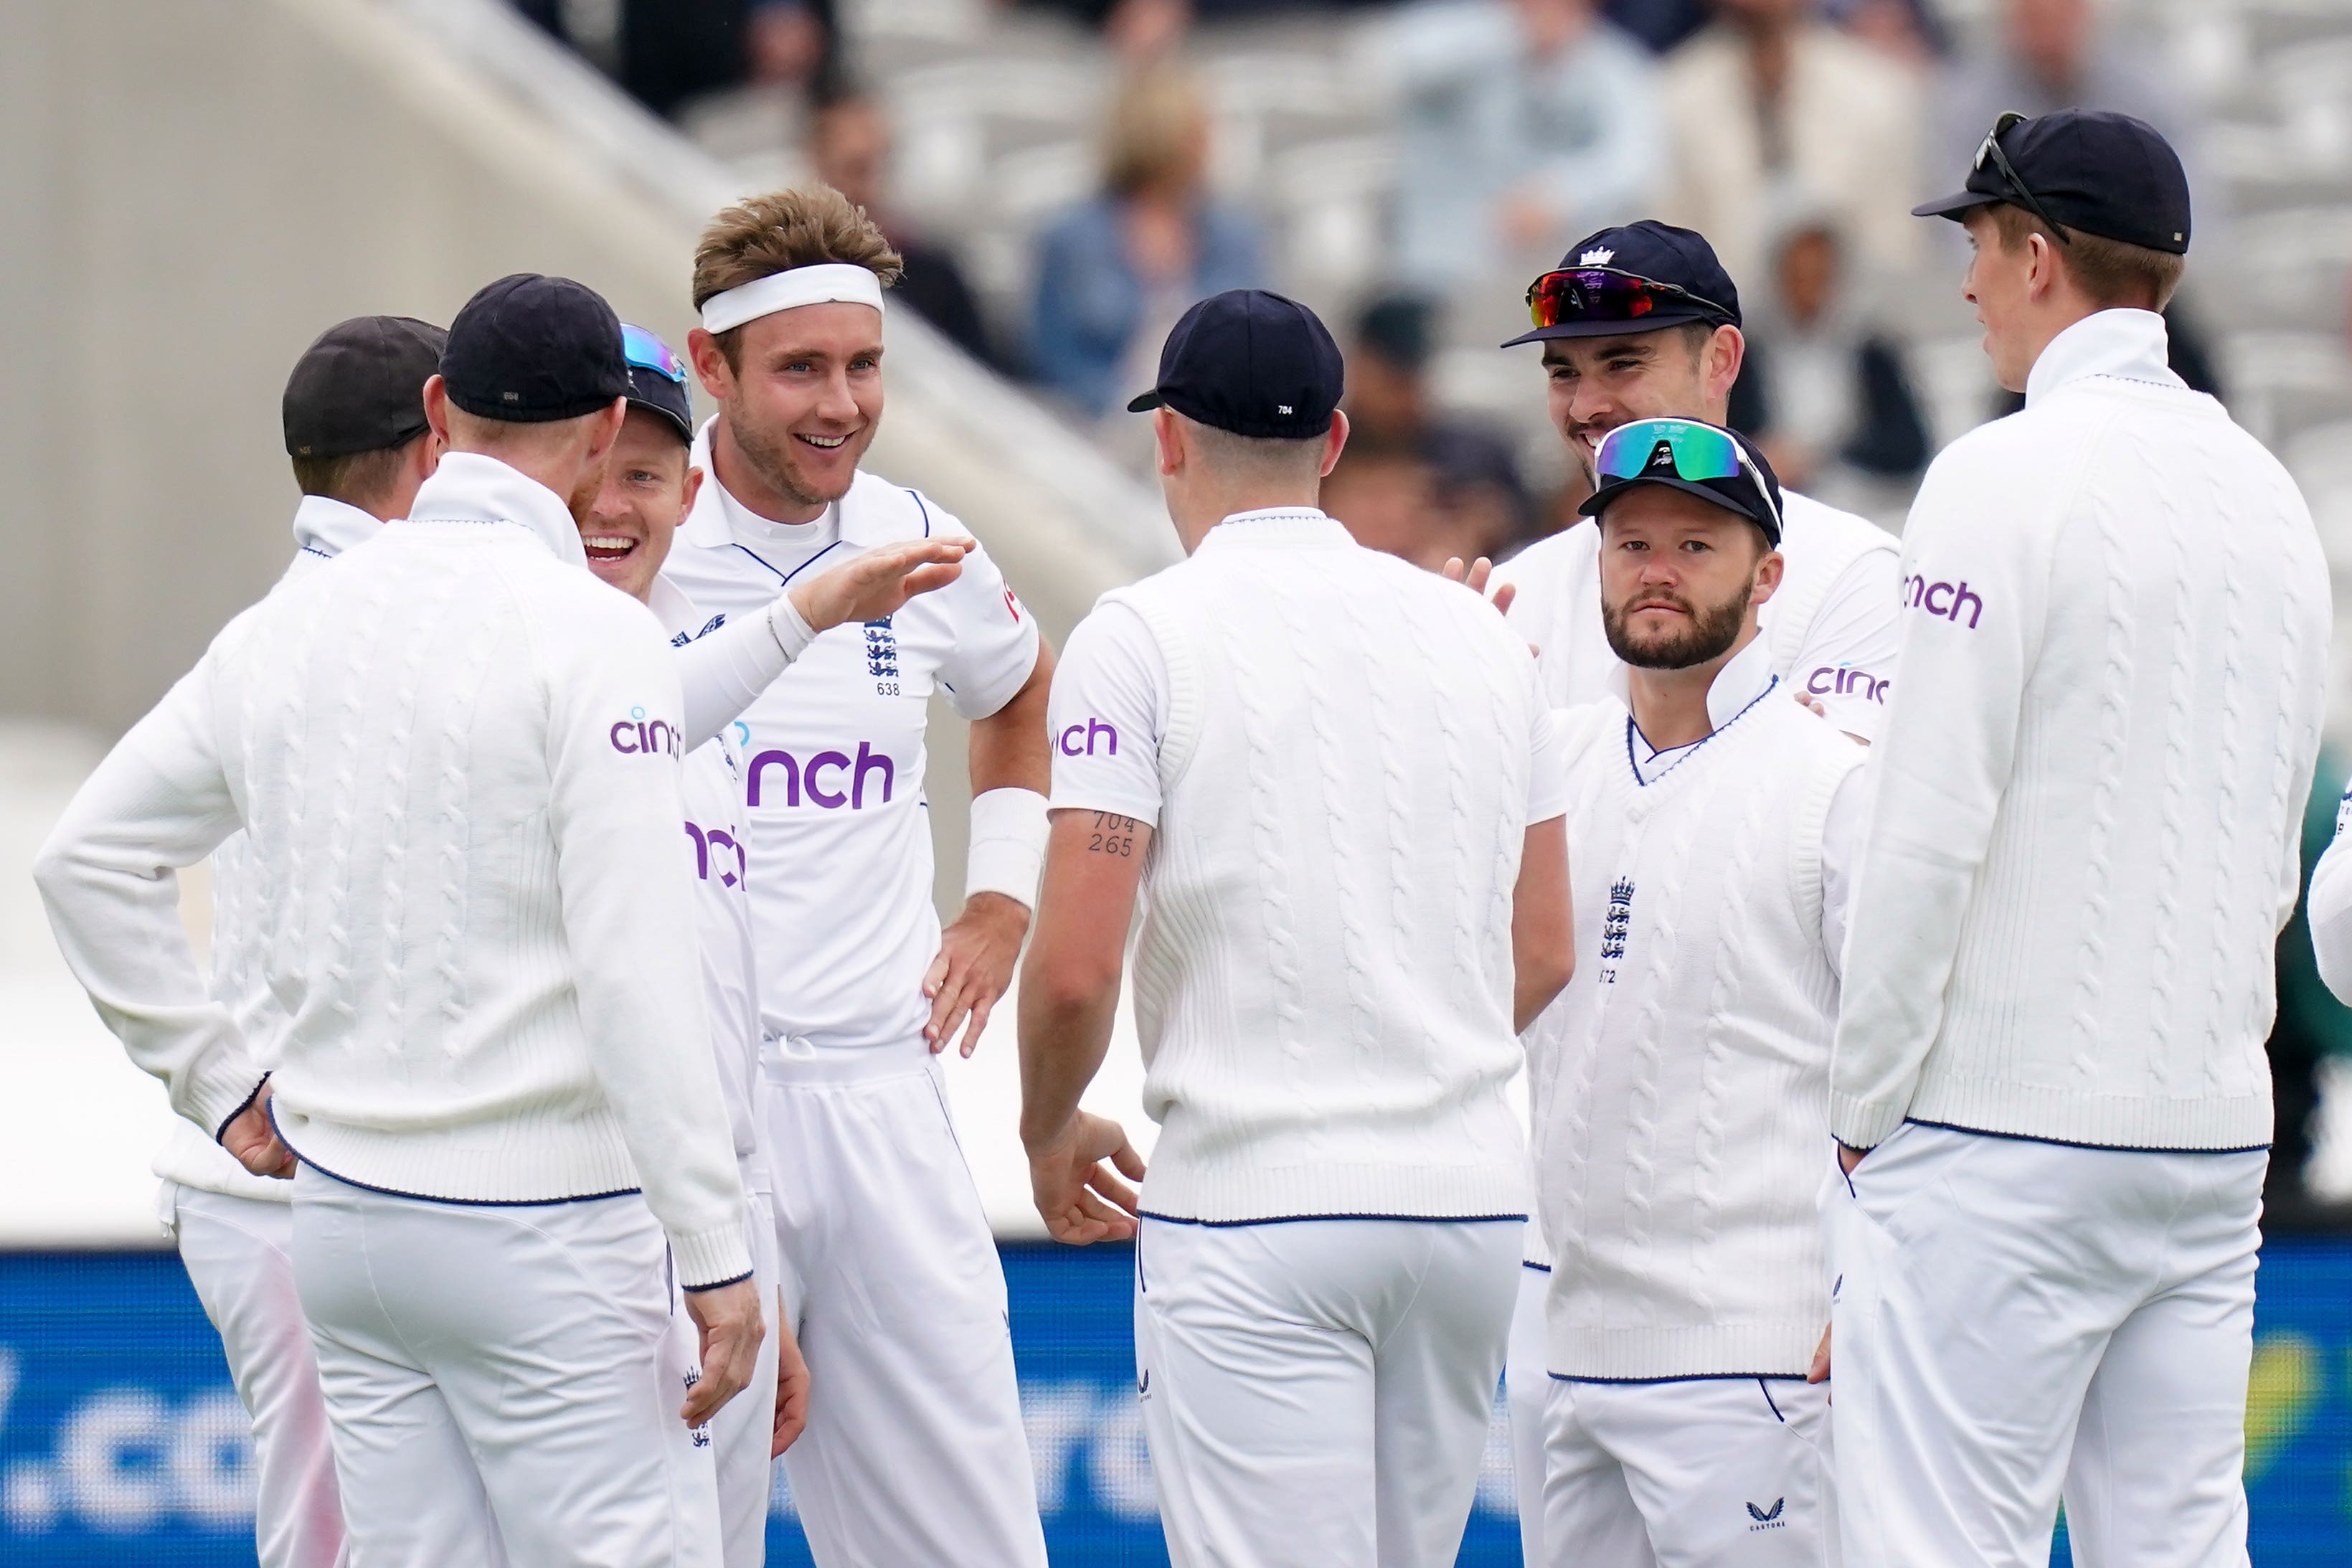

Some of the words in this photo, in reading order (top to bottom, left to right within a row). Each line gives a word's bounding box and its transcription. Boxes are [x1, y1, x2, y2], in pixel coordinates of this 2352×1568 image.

[1278, 405, 1293, 415] 704
[877, 682, 900, 696] 638
[736, 722, 894, 809] nch
[1093, 810, 1135, 833] 704
[1089, 833, 1133, 857] 265
[1750, 1521, 1785, 1531] CASTORE
